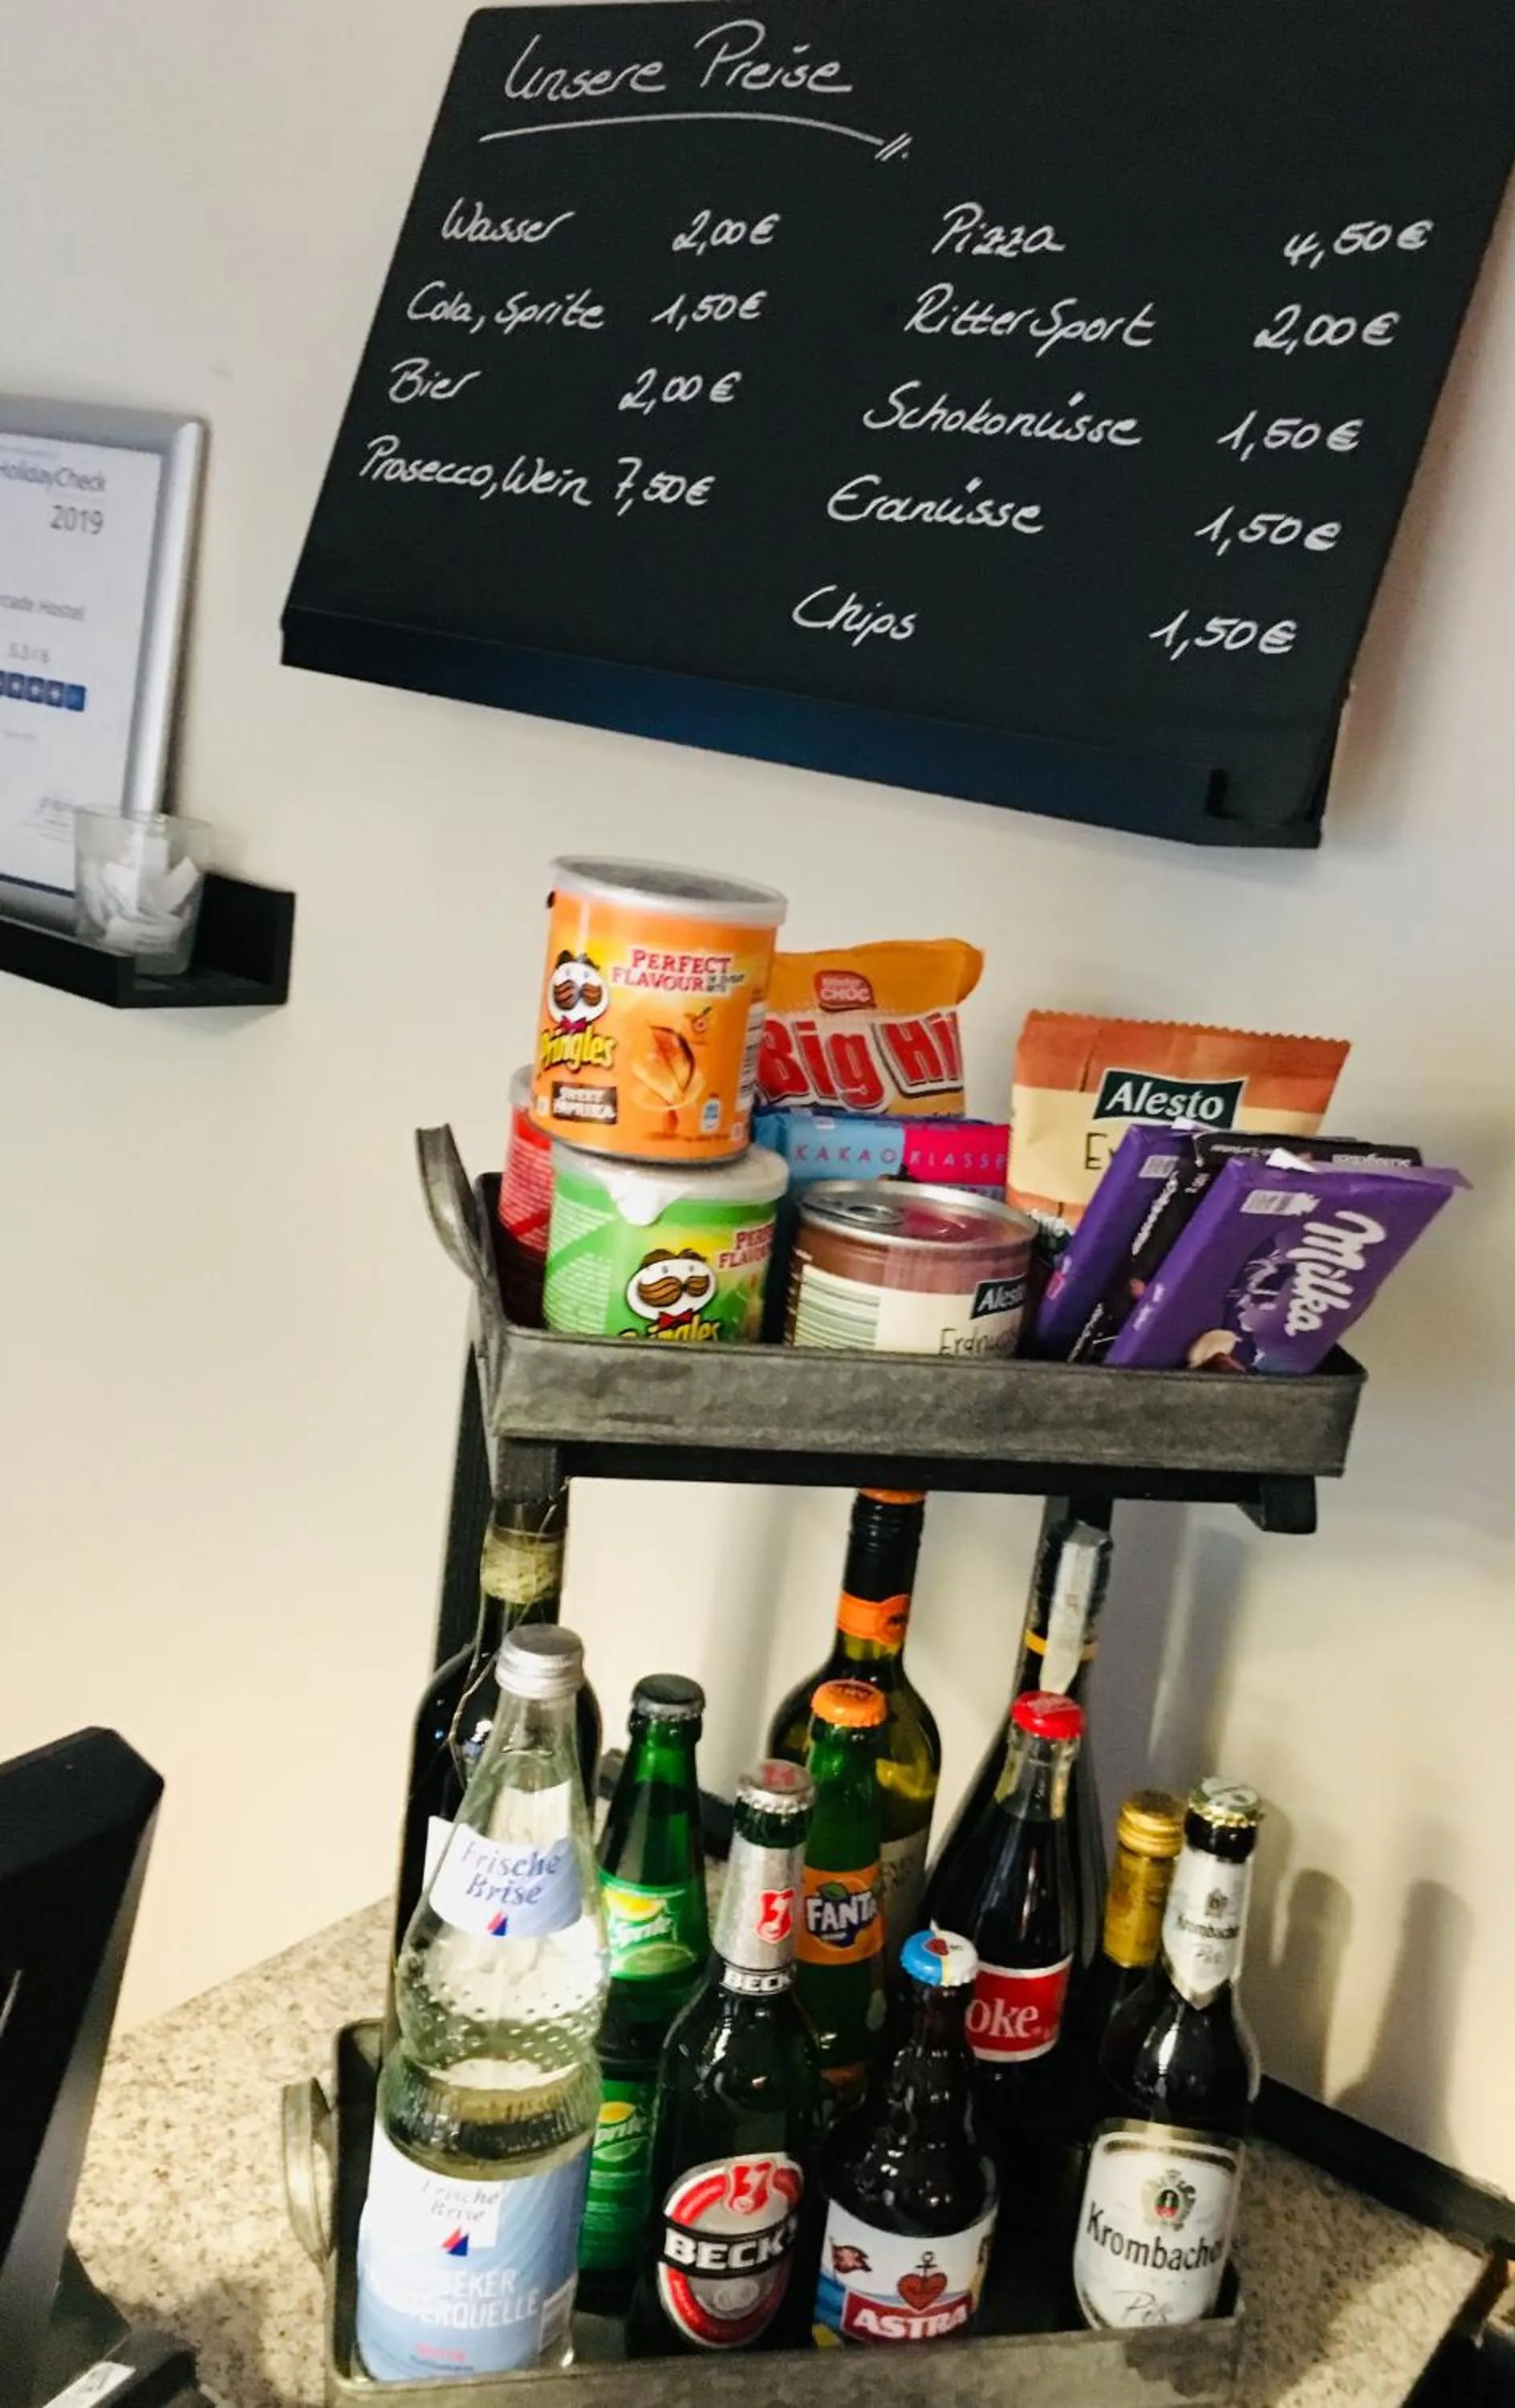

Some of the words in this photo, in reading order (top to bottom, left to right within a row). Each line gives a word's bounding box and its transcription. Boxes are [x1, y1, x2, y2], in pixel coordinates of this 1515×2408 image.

[505, 35, 666, 101] Unsere
[694, 19, 853, 93] Preise
[441, 197, 575, 243] Wasser
[672, 209, 781, 256] 2,00€
[932, 201, 1066, 258] Pizza
[1283, 220, 1434, 269] 4,50€
[494, 288, 604, 335] Sprite
[651, 290, 767, 332] 1,50€
[1253, 303, 1399, 356] 2,00€
[388, 357, 481, 404] Bier
[1217, 410, 1363, 462] 1,50€
[615, 457, 715, 517] 7,50€
[50, 504, 104, 535] 2019
[1194, 506, 1341, 556] 1,50€
[792, 584, 917, 647] Chips
[1148, 609, 1297, 661] 1,50€
[611, 966, 705, 993] FLAVOUR
[632, 948, 733, 974] PERFECT
[757, 1017, 887, 1111] Big
[1105, 1081, 1225, 1121] Alesto
[794, 1144, 898, 1164] KAKAO
[1284, 1210, 1387, 1337] Milka
[460, 1841, 561, 1878] Frische
[465, 1872, 543, 1906] Brise
[965, 1996, 1040, 2039] oke
[851, 2304, 969, 2341] ASTRA
